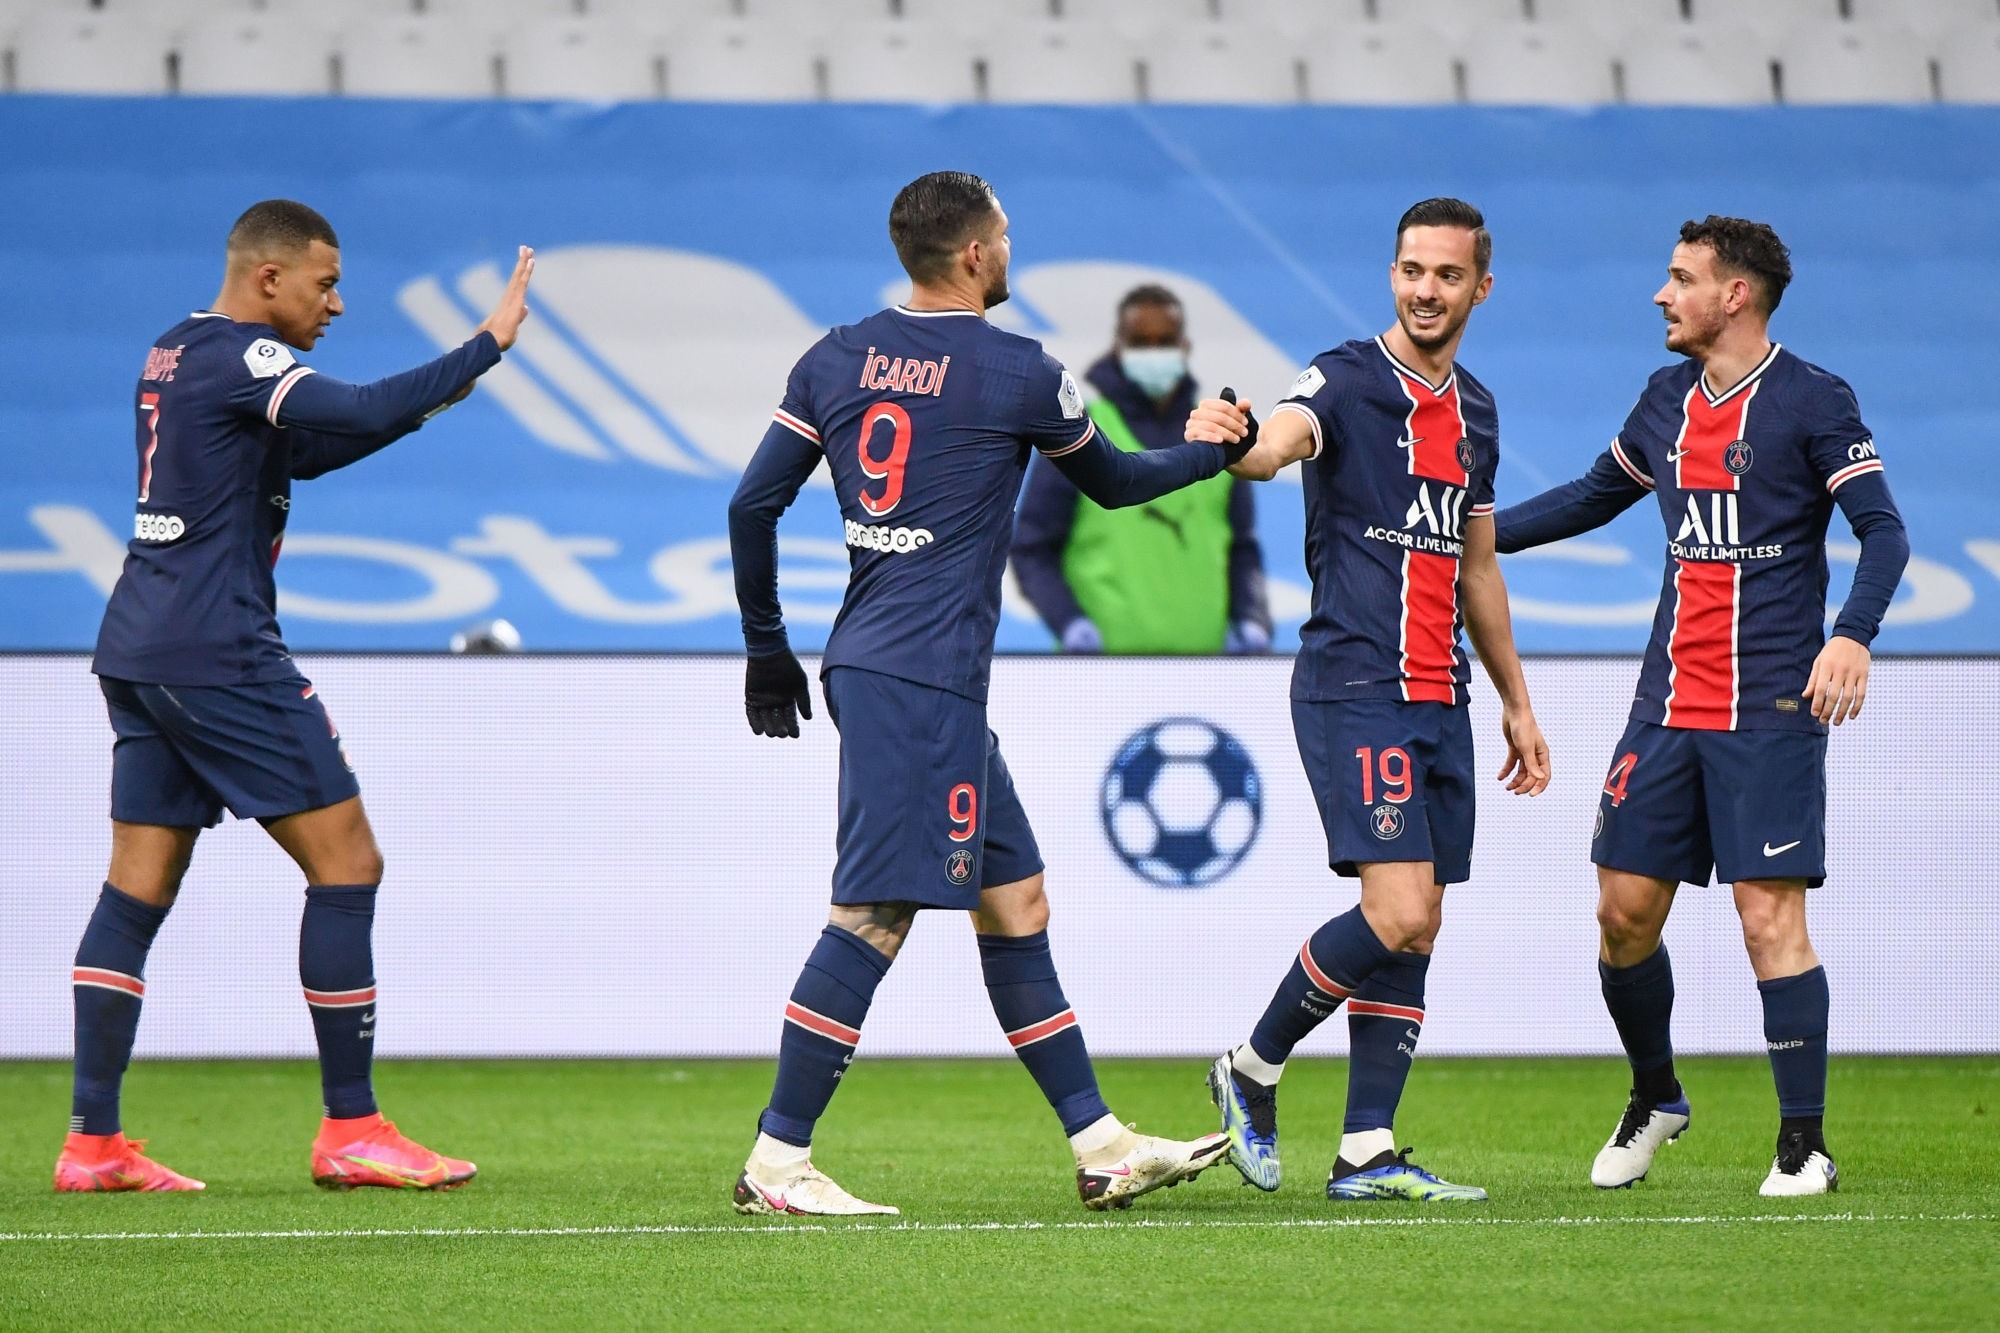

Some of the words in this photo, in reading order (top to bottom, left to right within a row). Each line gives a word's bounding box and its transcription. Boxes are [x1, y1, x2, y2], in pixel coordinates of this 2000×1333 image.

[137, 393, 160, 503] 7
[857, 401, 912, 517] 9
[1847, 438, 1877, 461] QN
[1363, 525, 1414, 548] ACCOR
[1415, 536, 1441, 552] LIVE
[1683, 546, 1709, 560] LIVE
[1711, 544, 1783, 560] LIMITLESS
[1355, 746, 1414, 806] 19
[948, 782, 978, 843] 9
